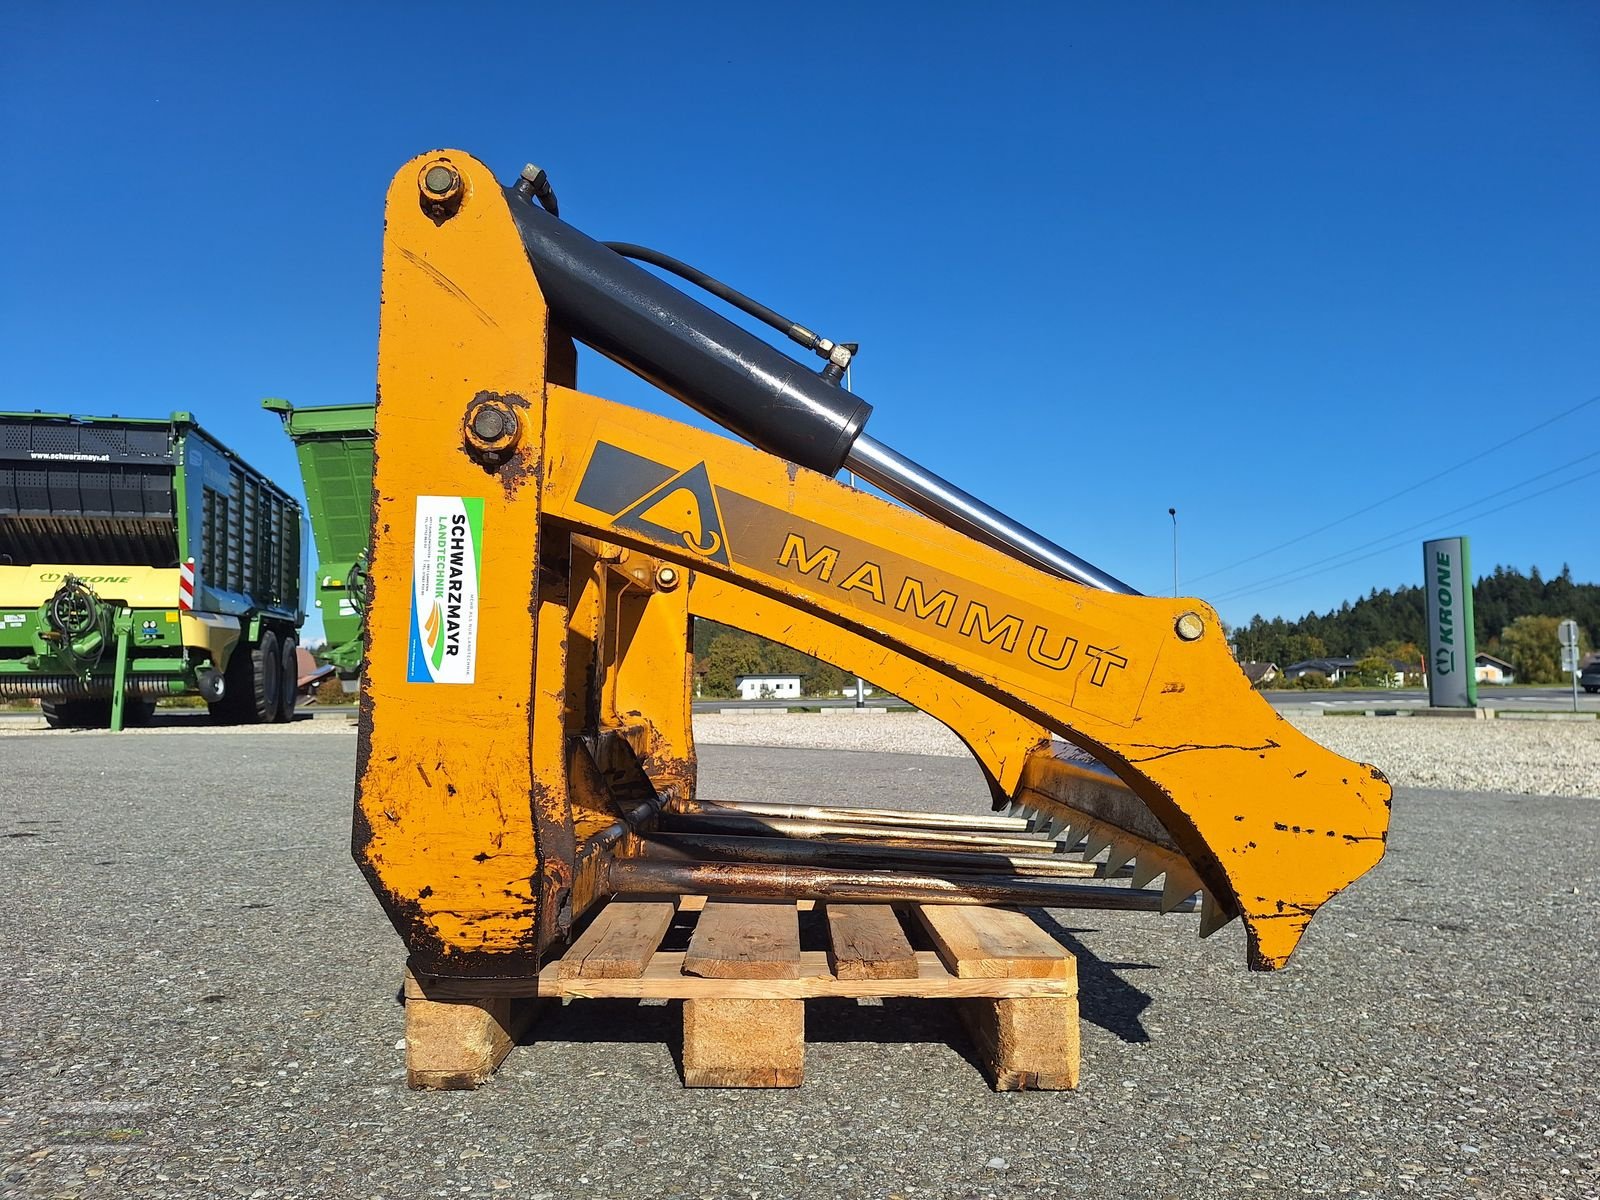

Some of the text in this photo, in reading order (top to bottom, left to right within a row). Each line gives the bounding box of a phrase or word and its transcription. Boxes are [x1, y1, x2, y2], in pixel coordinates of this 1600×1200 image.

[435, 516, 448, 599] LANDTECHNIK
[446, 514, 466, 656] SCHWARZMAYR
[777, 533, 1127, 687] MAMMUT
[1436, 551, 1454, 645] KRONE
